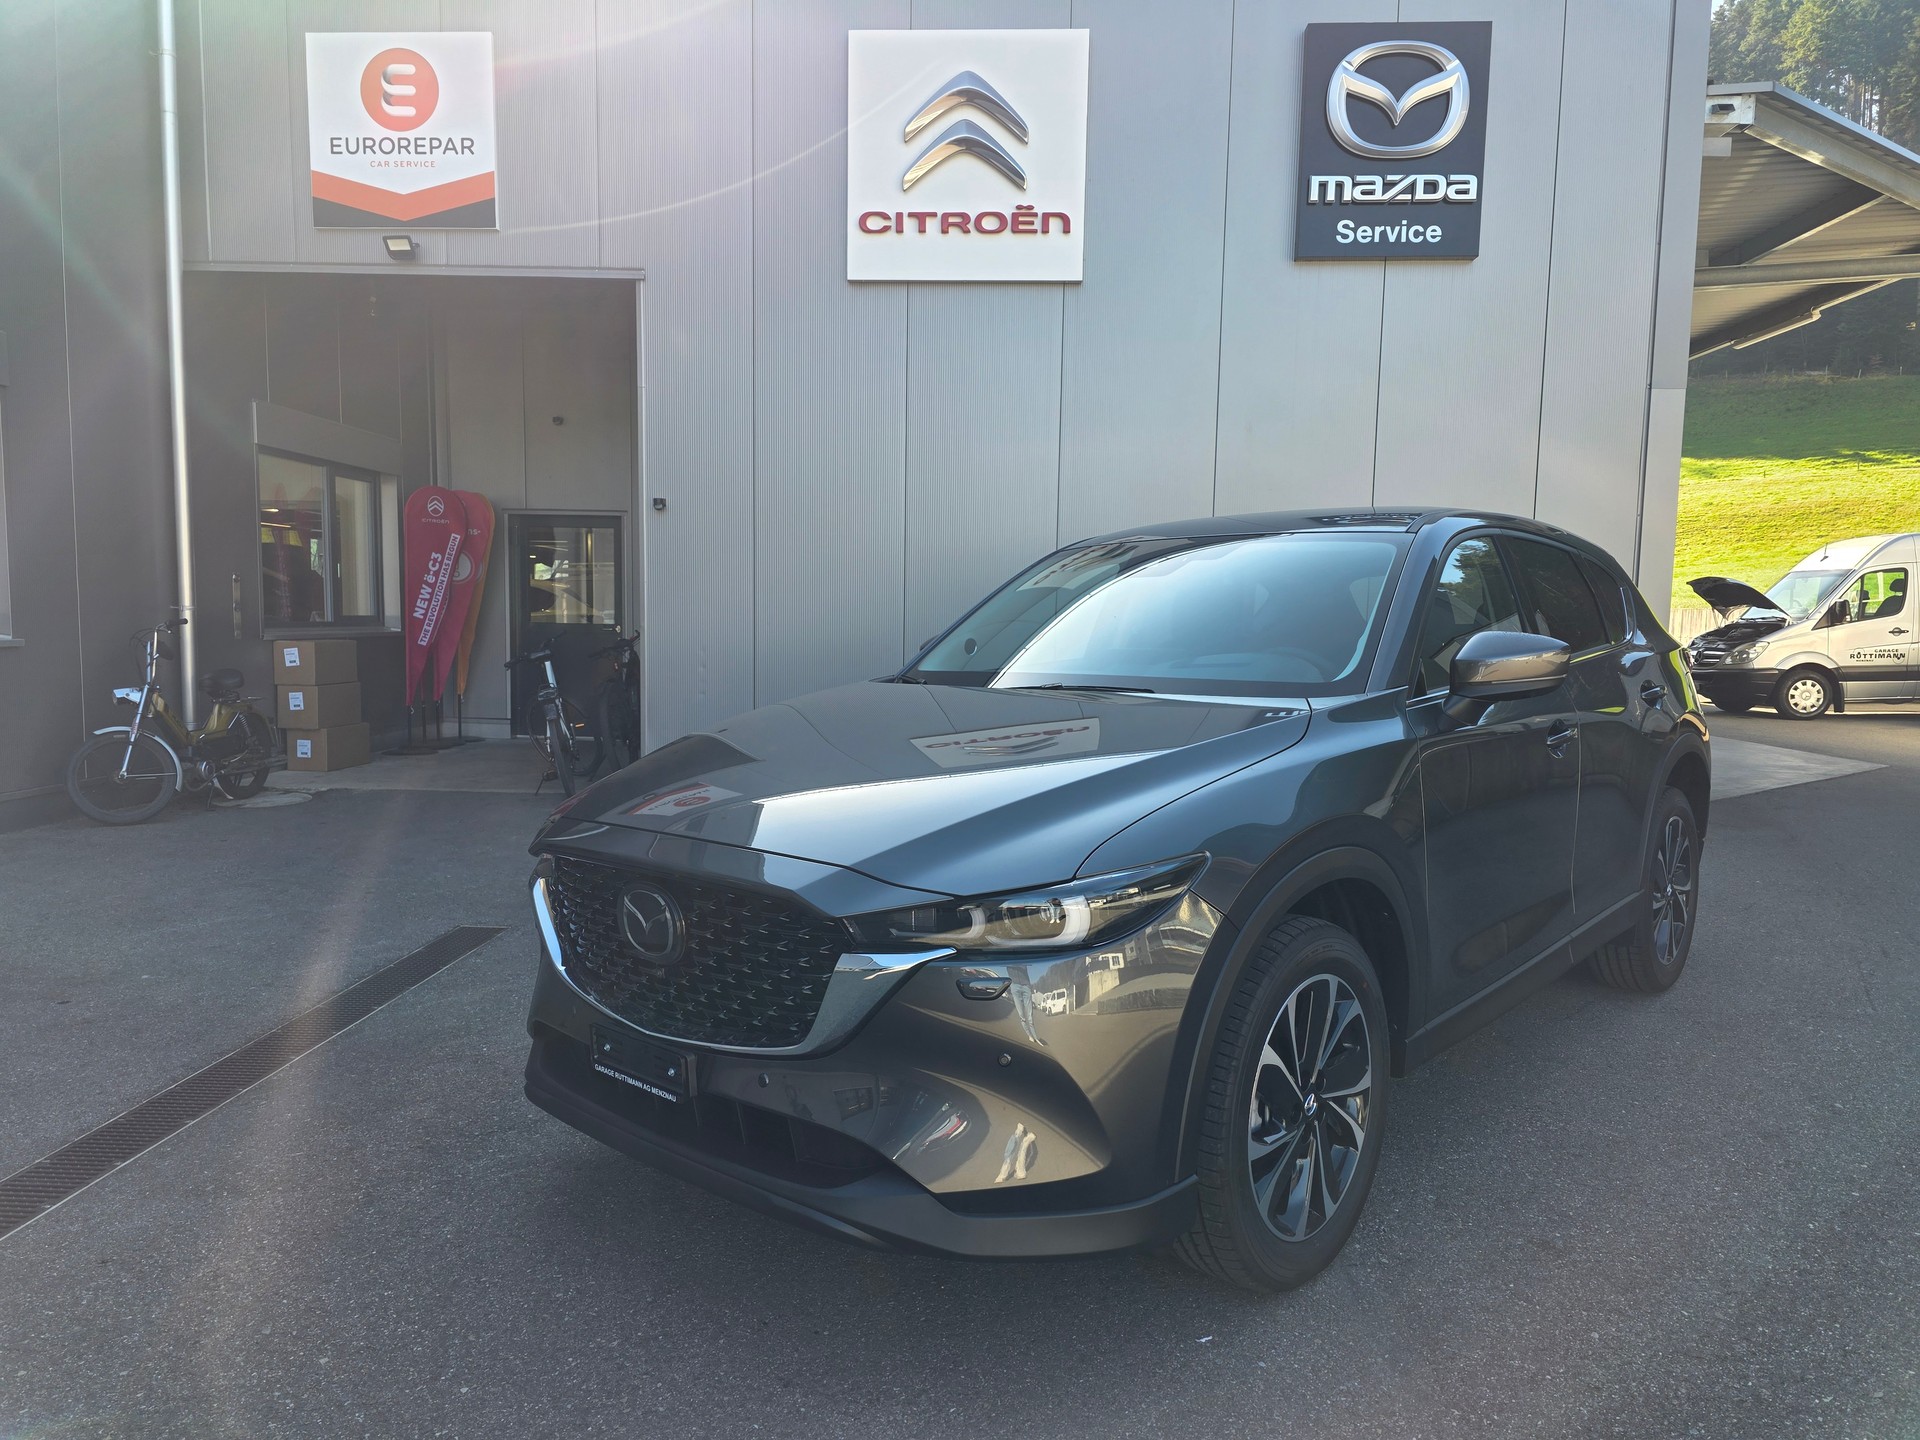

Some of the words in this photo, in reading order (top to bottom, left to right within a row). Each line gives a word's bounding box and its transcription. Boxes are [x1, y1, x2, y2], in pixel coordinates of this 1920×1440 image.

[330, 137, 475, 155] EUROREPAR
[370, 160, 390, 168] CAR
[393, 160, 436, 168] SERVICE
[1335, 219, 1443, 244] Service
[413, 583, 433, 620] NEW
[419, 628, 431, 645] THE
[426, 582, 445, 628] REVOLUTION
[441, 562, 451, 580] HAS
[447, 535, 459, 561] BEGUN
[594, 1063, 615, 1077] GARAGE
[643, 1084, 651, 1092] AG
[651, 1086, 677, 1102] MENZNAU
